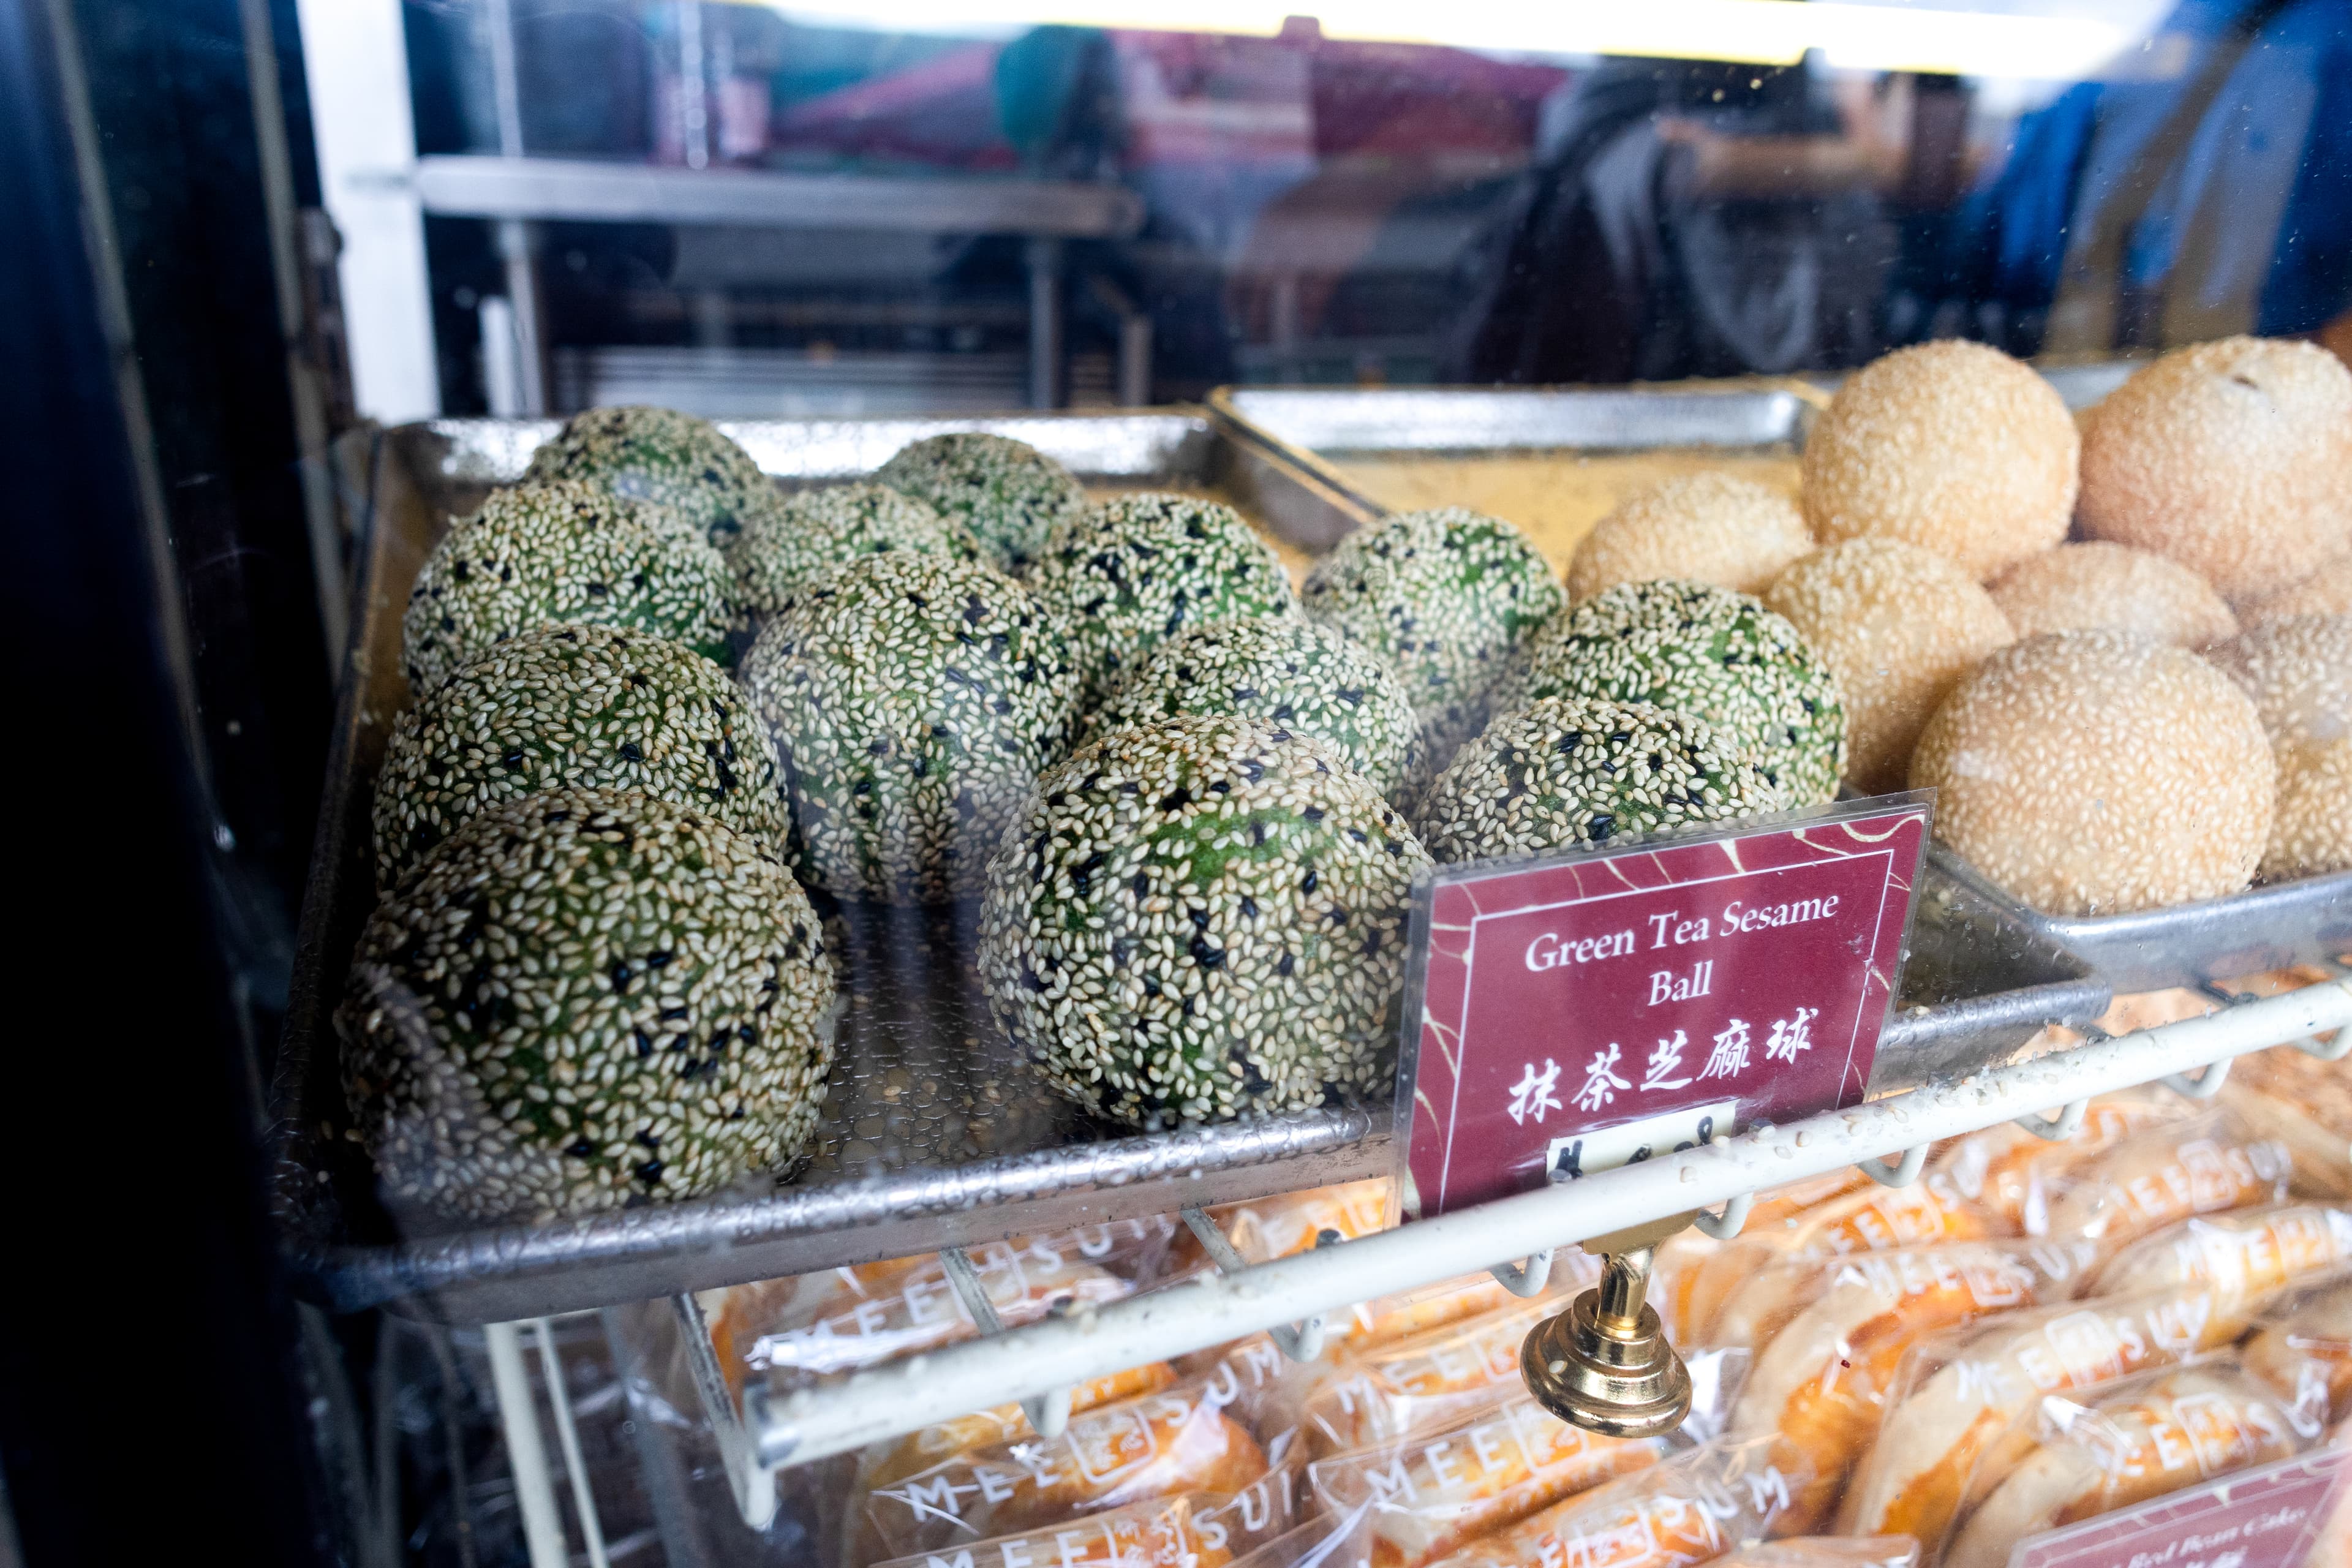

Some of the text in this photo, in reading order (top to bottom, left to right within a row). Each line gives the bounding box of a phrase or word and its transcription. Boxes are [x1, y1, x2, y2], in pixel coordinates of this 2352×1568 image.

[1525, 894, 1839, 973] Green Tea Sesame
[1648, 960, 1714, 1008] Ball
[1507, 1007, 1820, 1126] 抹茶芝麻球
[1365, 1423, 1507, 1502] MEE
